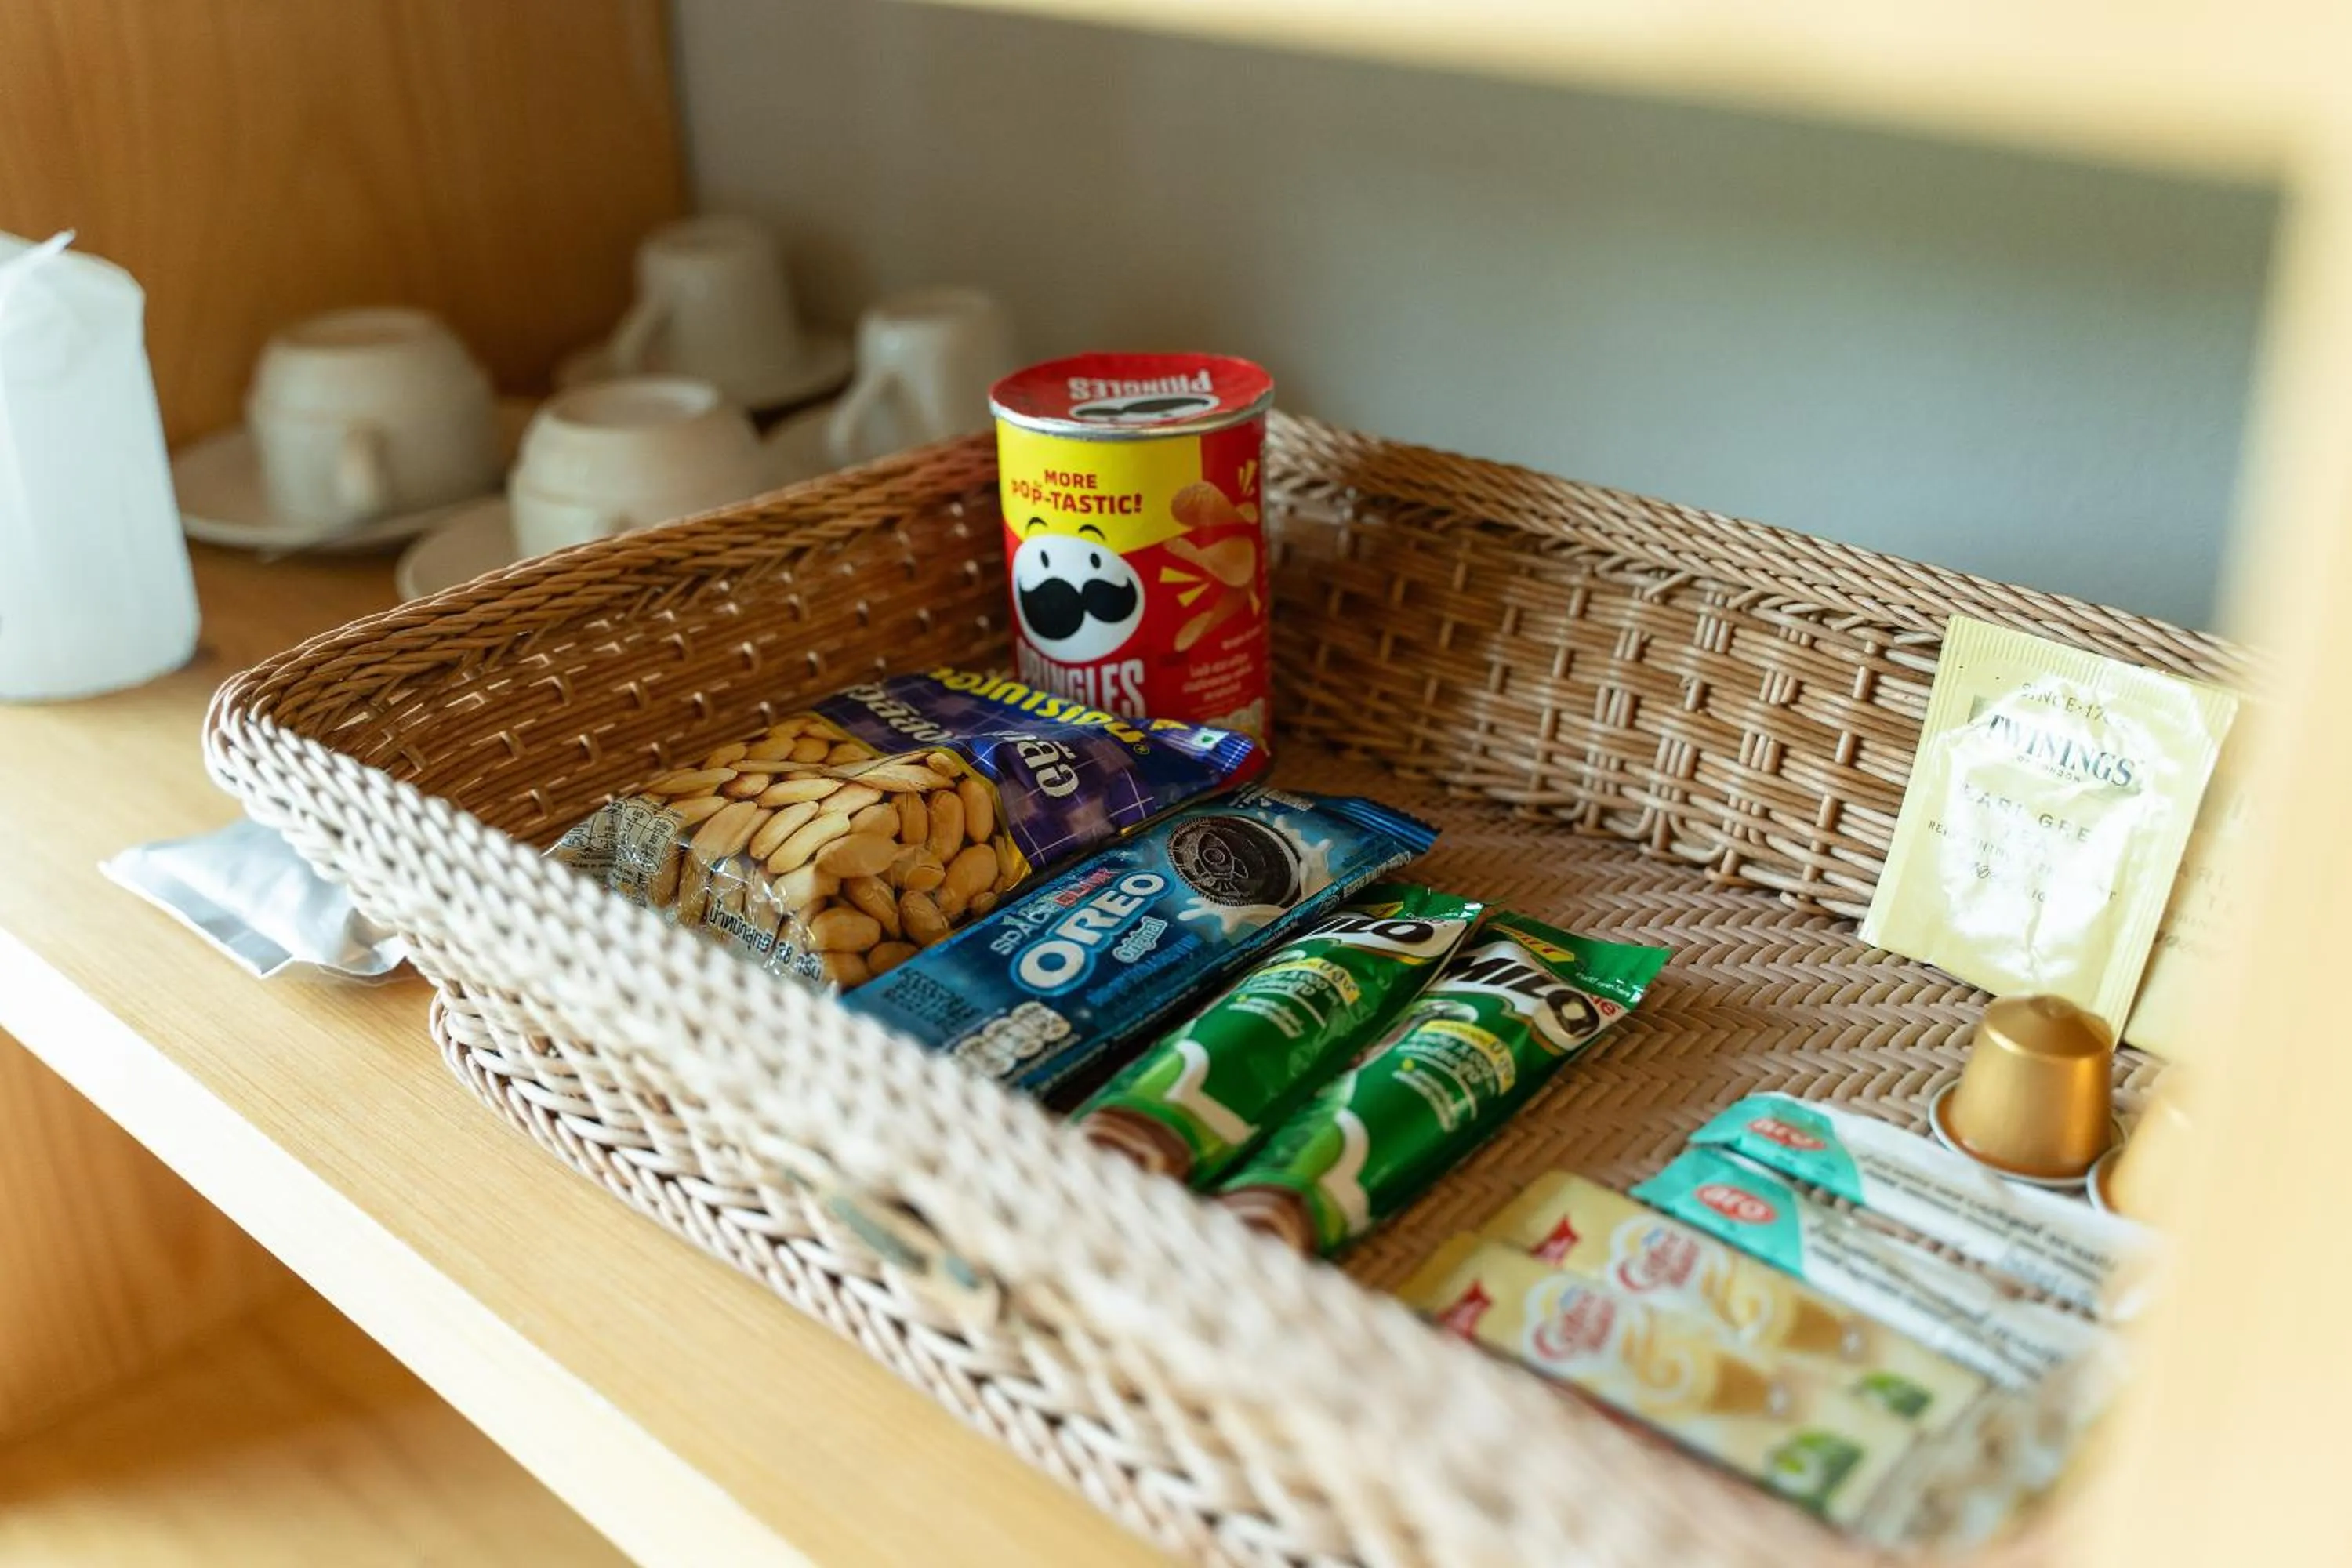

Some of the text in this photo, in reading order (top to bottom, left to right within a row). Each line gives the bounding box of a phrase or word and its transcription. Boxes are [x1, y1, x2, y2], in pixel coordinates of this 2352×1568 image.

[1066, 369, 1214, 401] PRINGLES
[1044, 469, 1098, 489] MORE
[1011, 479, 1143, 515] POP-TASTIC!
[1987, 713, 2136, 787] TWININGS
[2038, 812, 2092, 844] GRE
[1019, 873, 1166, 989] OREO
[1303, 916, 1436, 946] ILO
[1437, 956, 1601, 1038] MILO
[1751, 1119, 1817, 1147] aro
[1701, 1186, 1769, 1221] aro
